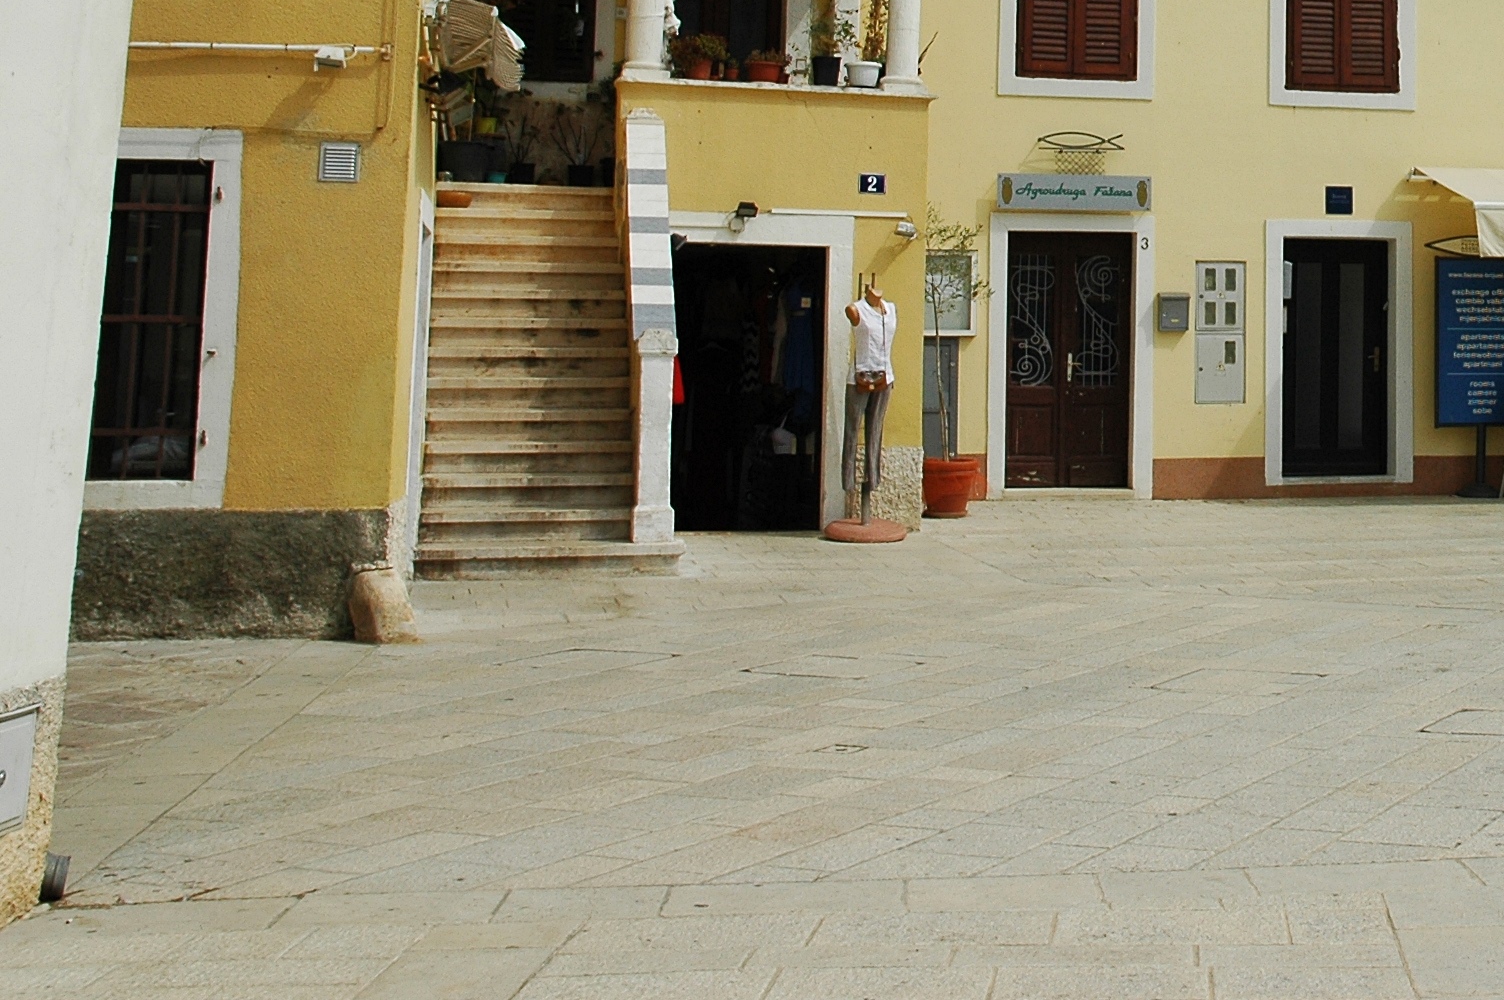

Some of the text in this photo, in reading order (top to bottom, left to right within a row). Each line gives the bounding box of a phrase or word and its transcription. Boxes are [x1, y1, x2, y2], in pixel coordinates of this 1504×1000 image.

[867, 175, 877, 192] 2
[1015, 182, 1087, 200] Agroudruga
[1140, 237, 1149, 250] 3
